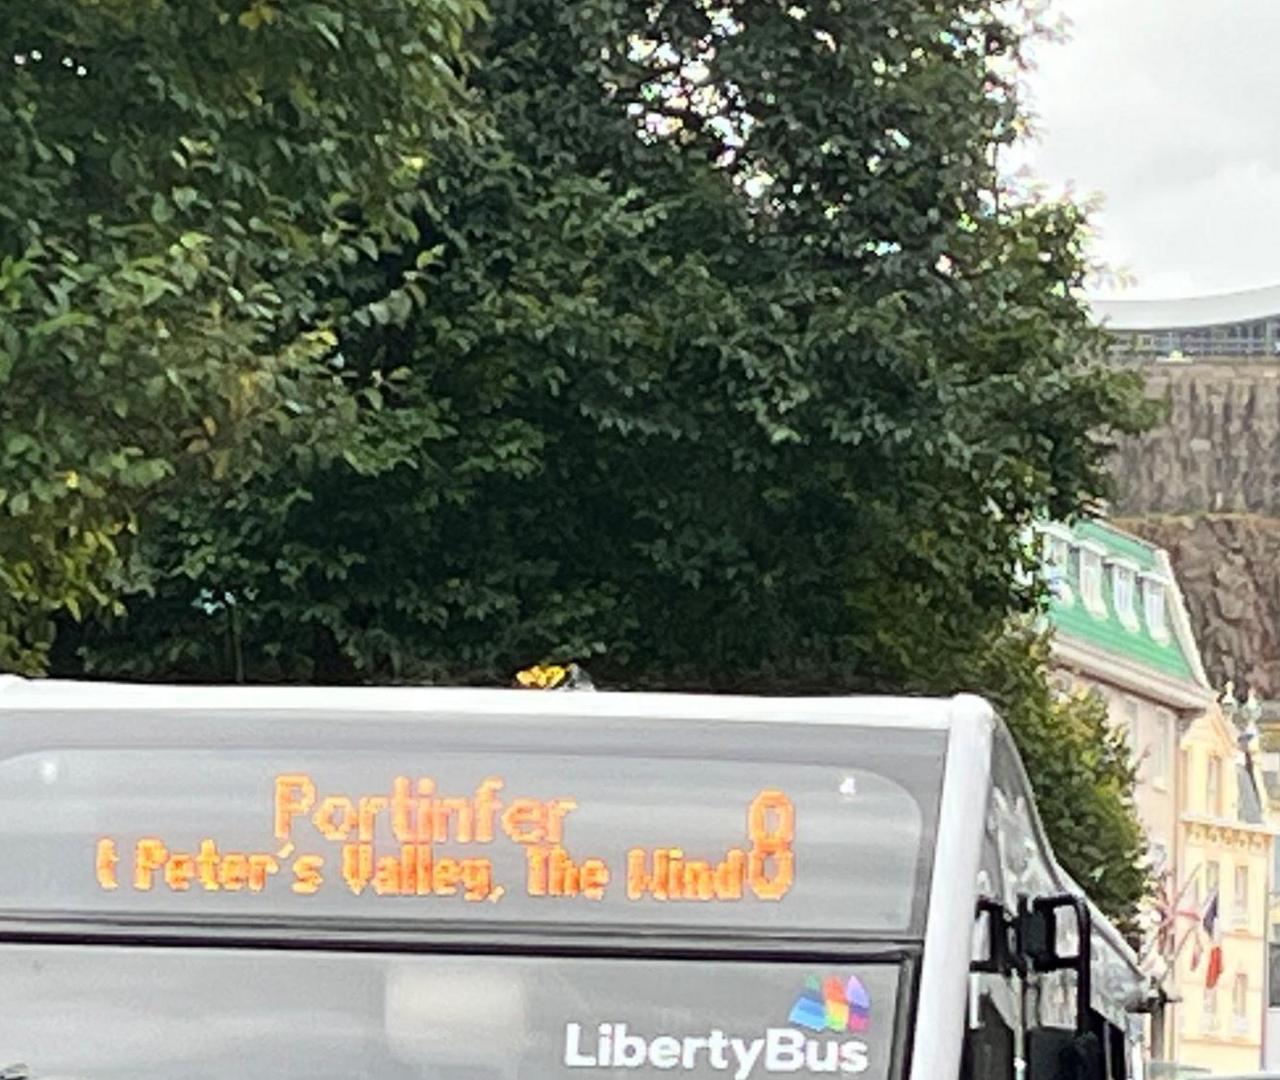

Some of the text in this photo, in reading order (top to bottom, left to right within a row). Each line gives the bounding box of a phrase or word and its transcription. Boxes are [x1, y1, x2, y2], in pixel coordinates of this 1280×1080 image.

[274, 772, 579, 842] Portinfer
[133, 838, 325, 895] Peter's
[341, 841, 505, 902] Valley,
[525, 843, 611, 899] The
[747, 787, 796, 900] 8
